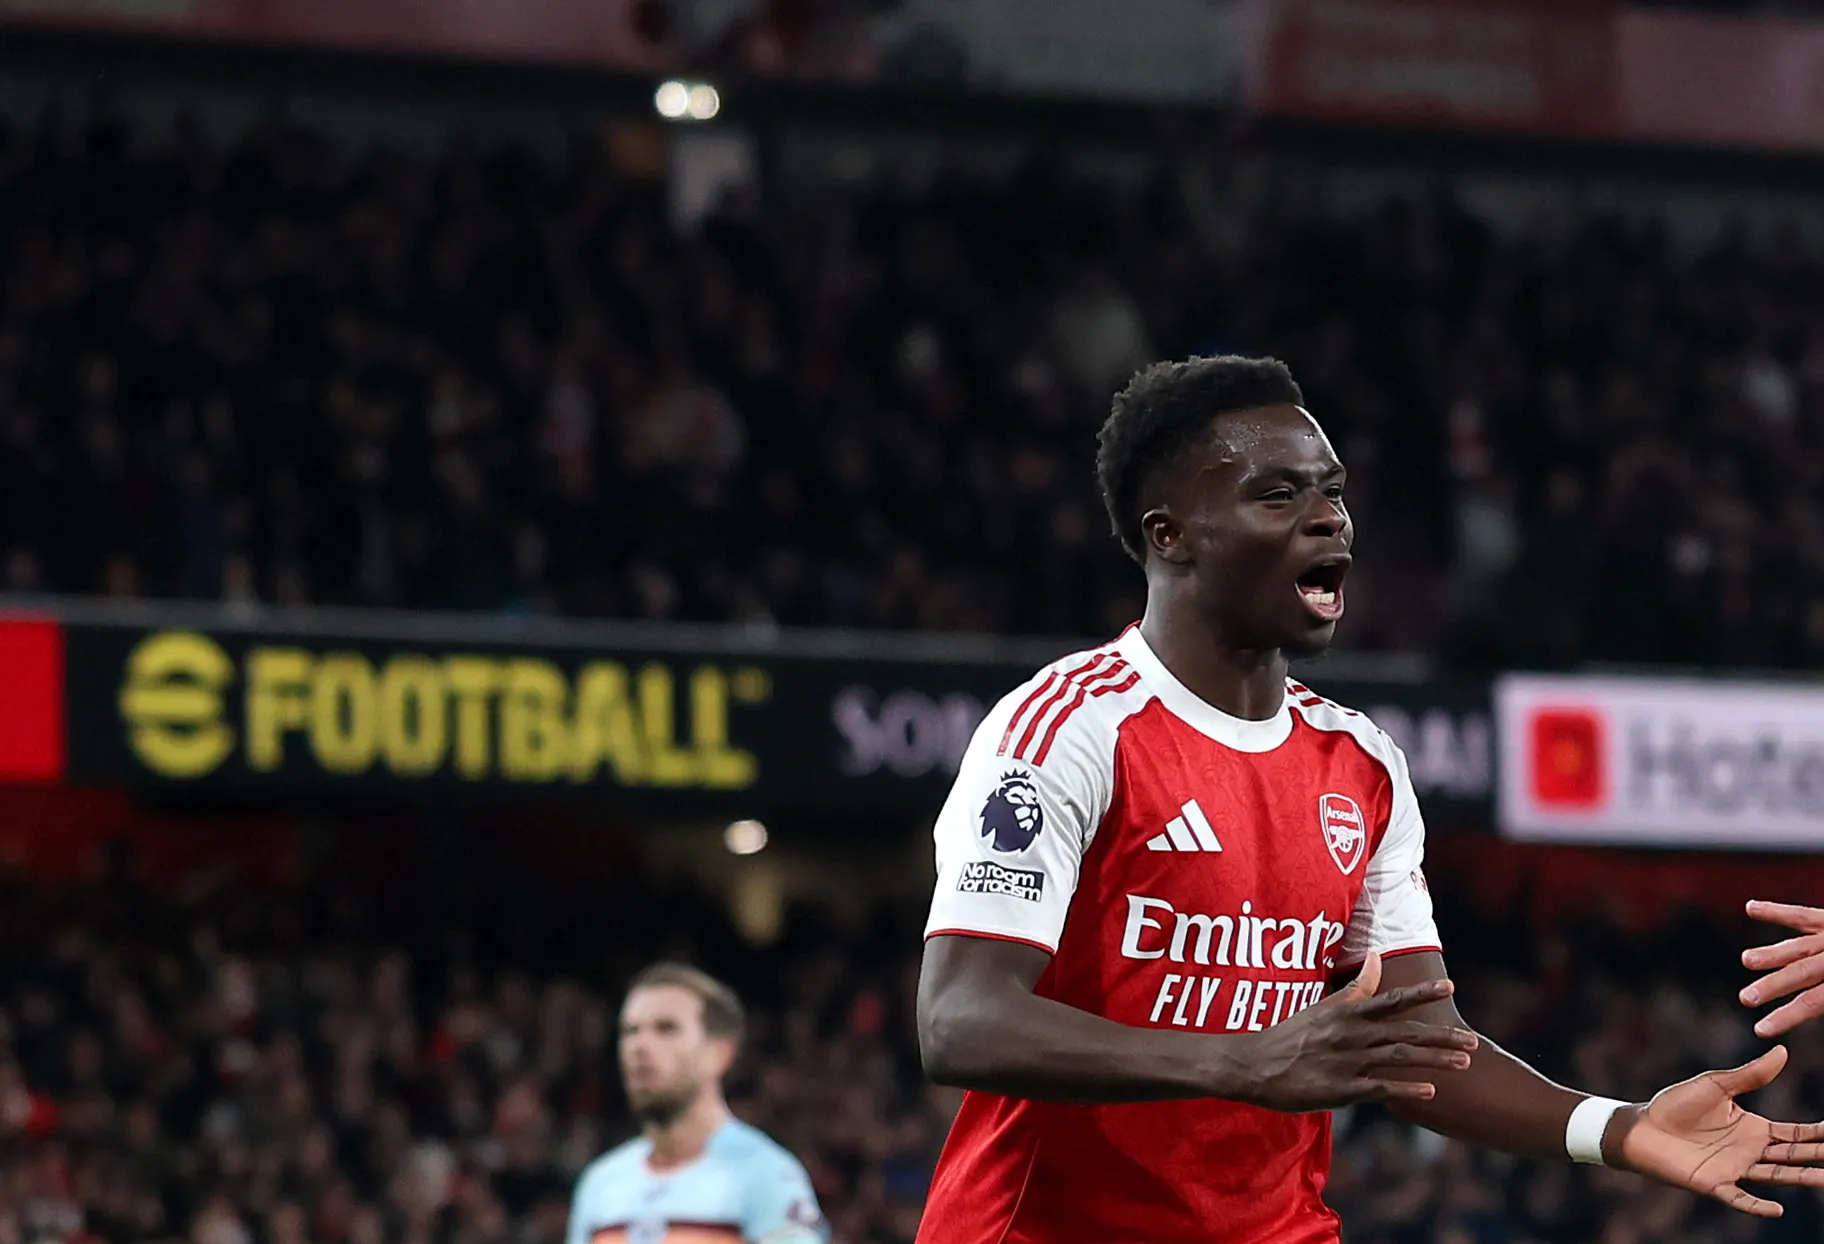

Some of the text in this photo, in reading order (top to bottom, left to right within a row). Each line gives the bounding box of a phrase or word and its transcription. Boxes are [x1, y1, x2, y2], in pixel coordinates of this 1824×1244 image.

[1326, 805, 1361, 823] Arsenal
[961, 862, 1036, 887] No room
[982, 878, 1041, 901] racism
[1121, 893, 1345, 970] Emirate
[1149, 973, 1222, 1028] FLY
